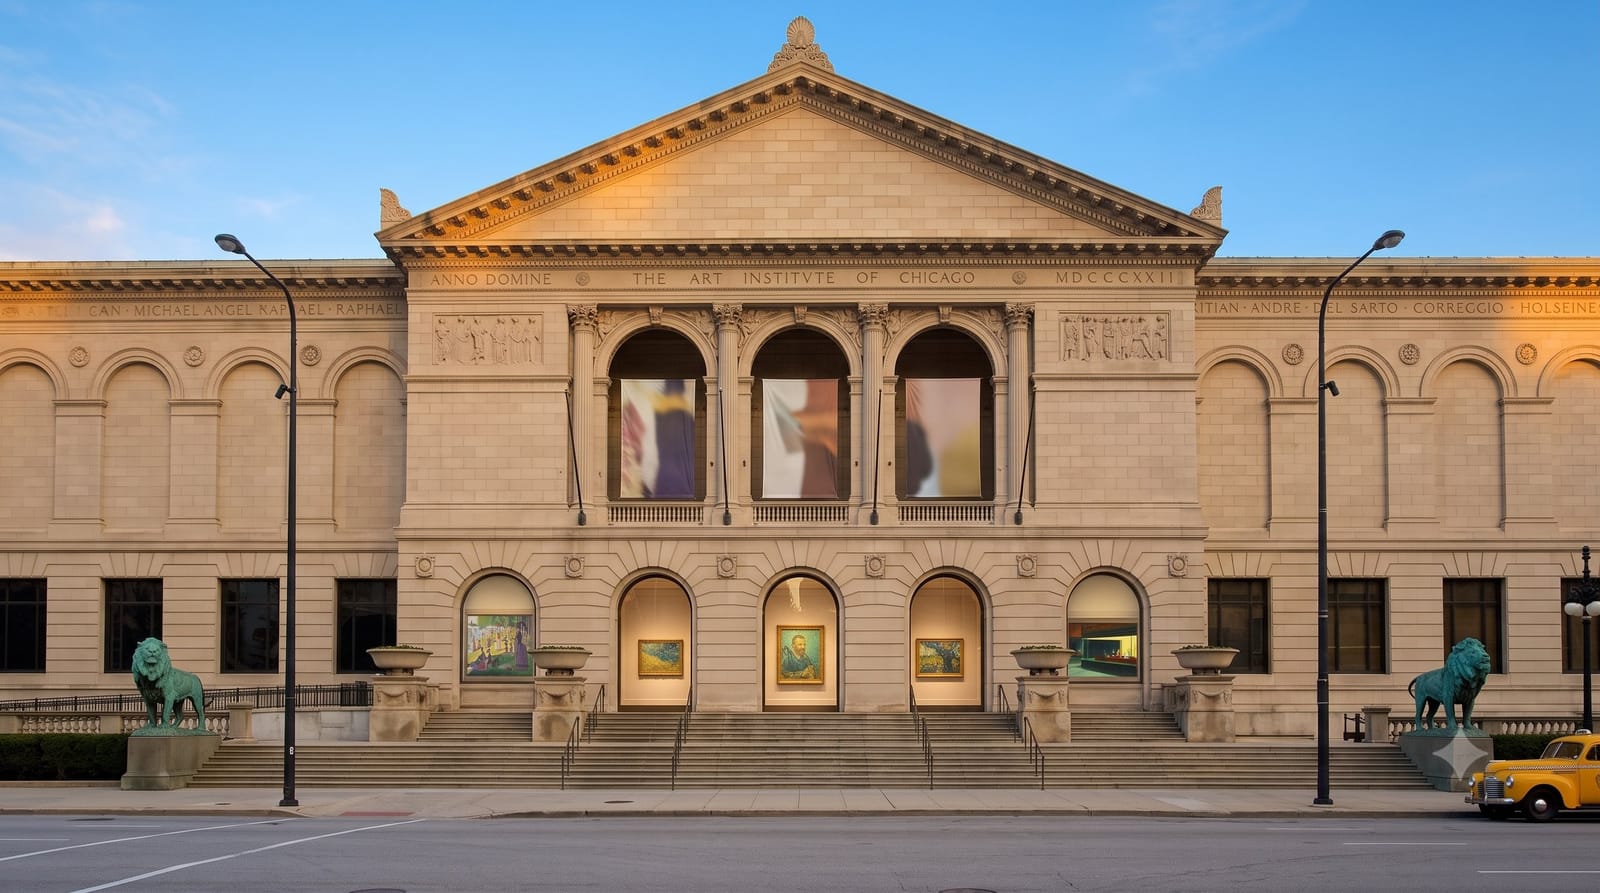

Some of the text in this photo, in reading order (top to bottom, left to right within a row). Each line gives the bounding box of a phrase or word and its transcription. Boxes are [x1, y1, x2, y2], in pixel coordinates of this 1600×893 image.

[430, 273, 552, 286] ANNO DOMINE
[633, 271, 975, 285] THE ART INSTITVTE OF CHICAGO
[134, 305, 200, 317] MICHAEL
[205, 304, 252, 316] ANGEL
[336, 303, 402, 316] RAPHAEL
[1250, 302, 1300, 313] ANDRE
[1350, 302, 1398, 314] SARTO
[1413, 302, 1504, 314] CORREGGIO
[1520, 302, 1600, 314] HOLSEINE
